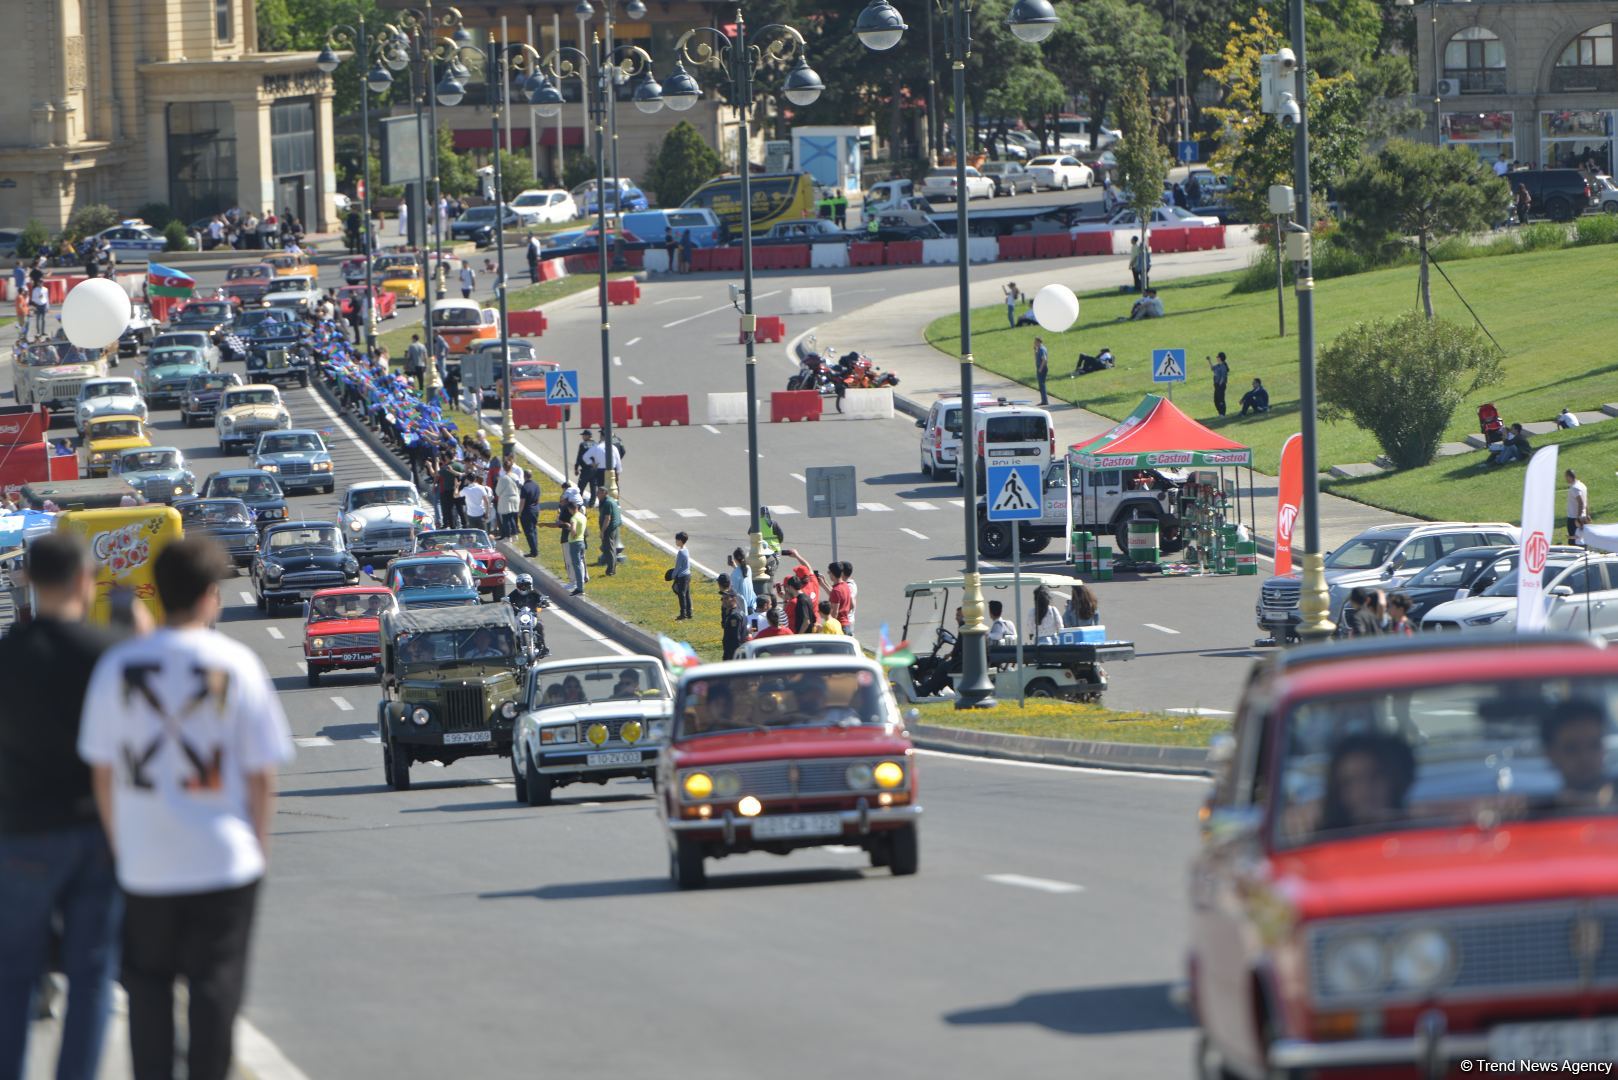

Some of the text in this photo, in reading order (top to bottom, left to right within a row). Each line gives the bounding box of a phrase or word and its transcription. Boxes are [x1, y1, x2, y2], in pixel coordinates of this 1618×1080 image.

[1102, 457, 1135, 467] Castrol
[1158, 454, 1190, 464] Castrol
[1214, 453, 1247, 463] Castrol
